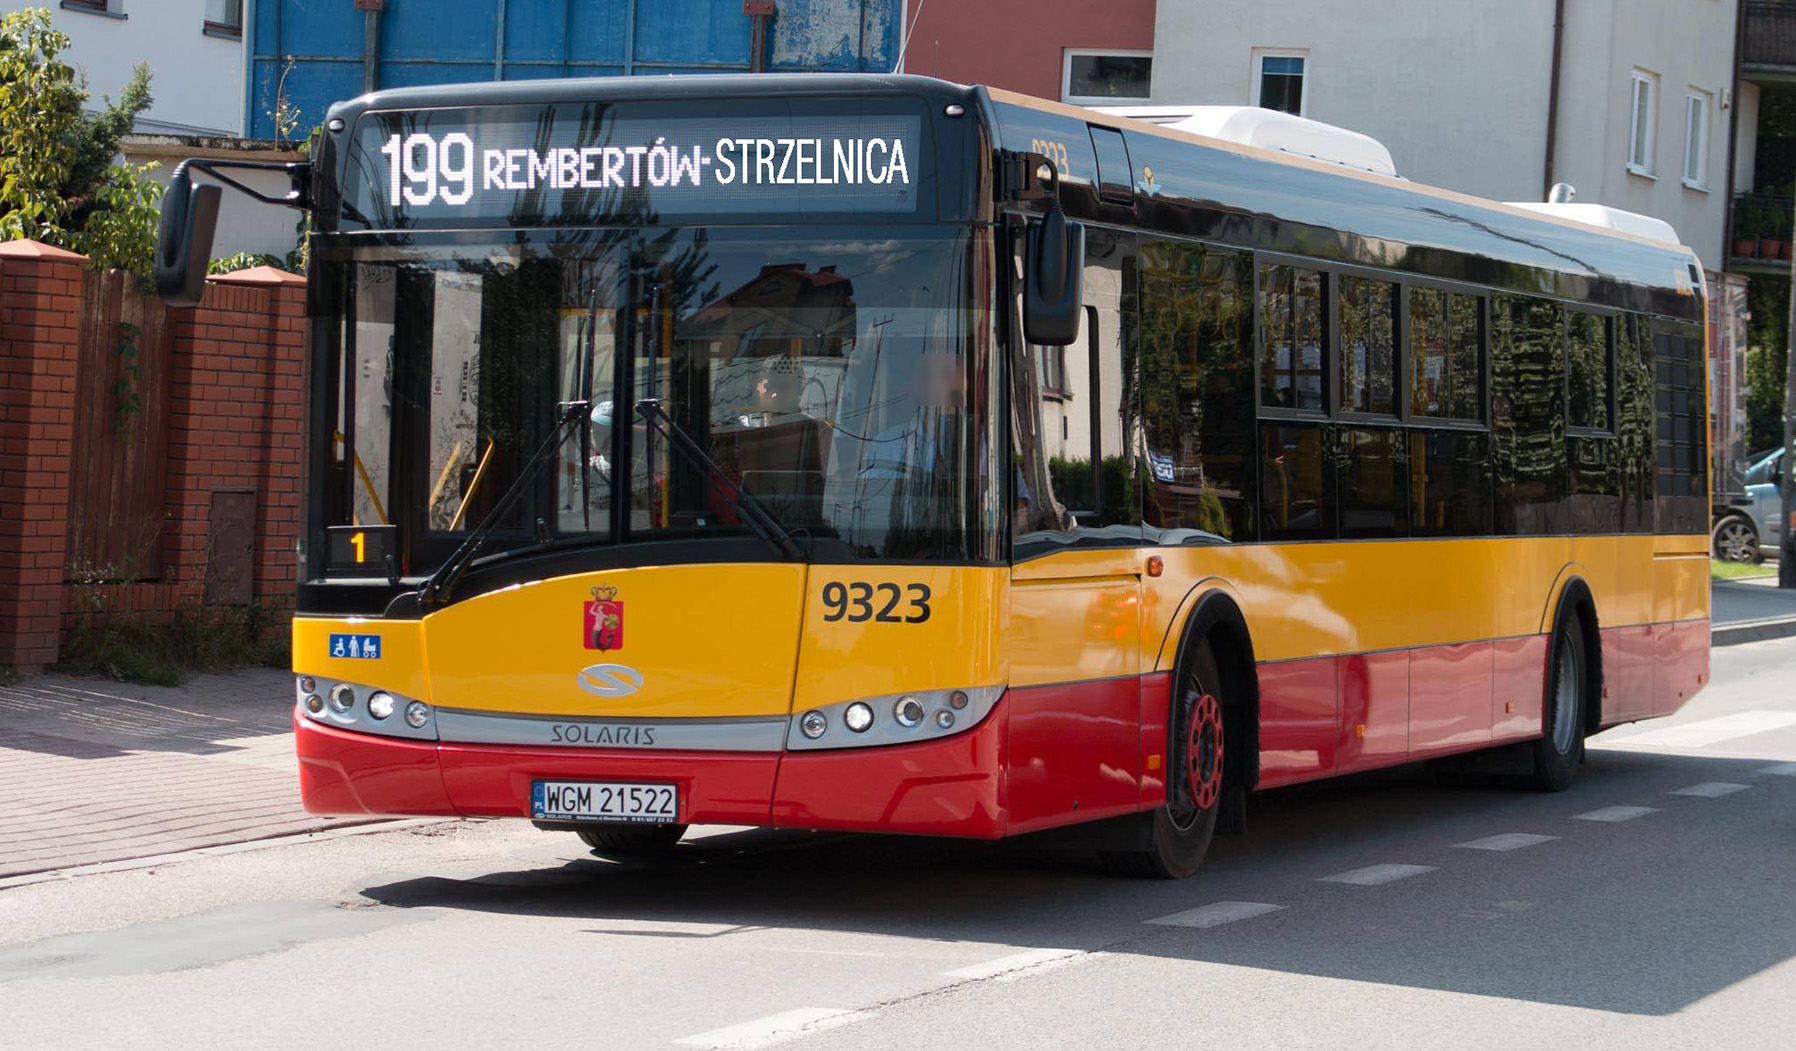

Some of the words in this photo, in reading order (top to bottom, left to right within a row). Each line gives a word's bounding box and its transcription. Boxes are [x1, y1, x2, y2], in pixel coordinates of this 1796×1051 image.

[381, 132, 474, 206] 199
[351, 532, 365, 563] 1
[822, 581, 932, 624] 9323
[551, 724, 656, 746] SOLARIS
[547, 786, 592, 812] WGM
[600, 787, 673, 815] 21522
